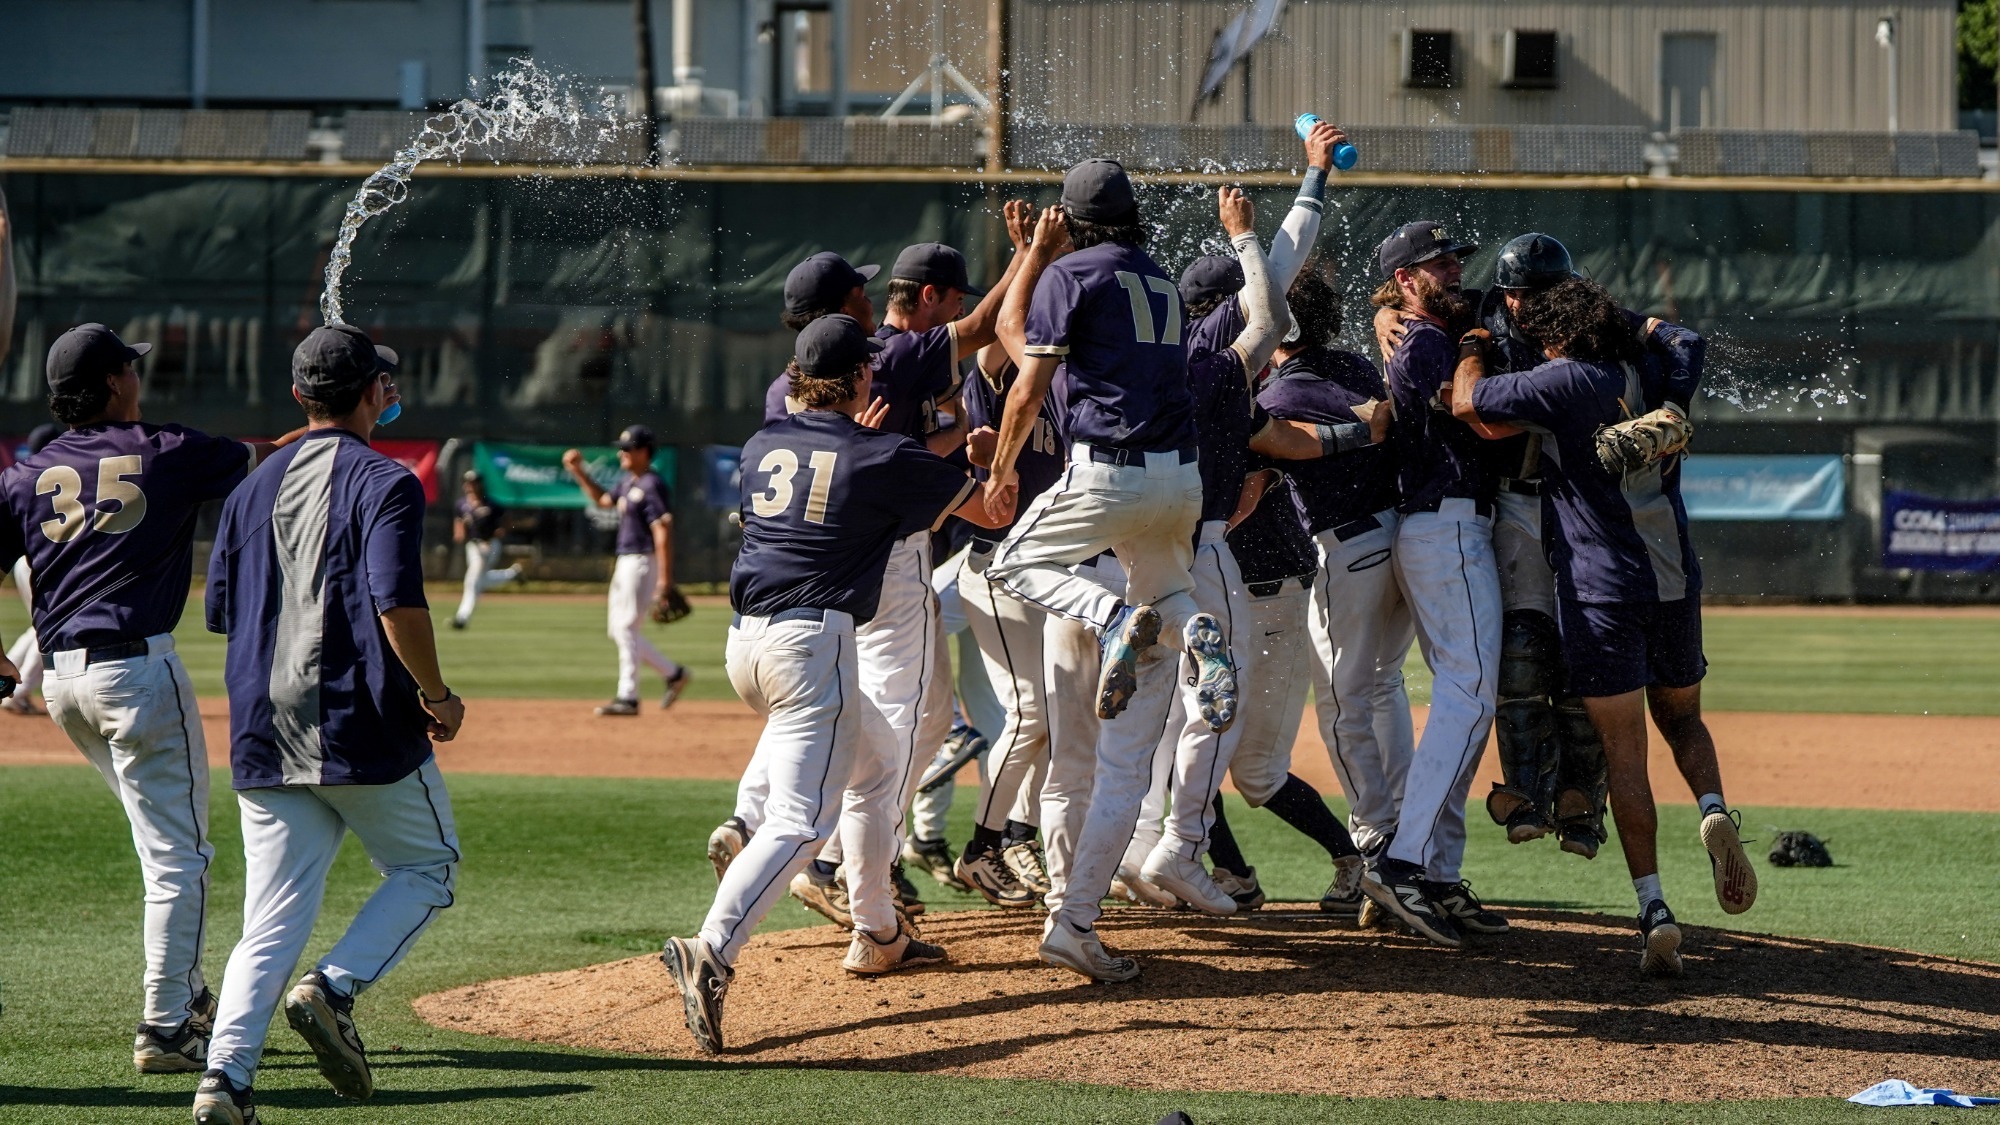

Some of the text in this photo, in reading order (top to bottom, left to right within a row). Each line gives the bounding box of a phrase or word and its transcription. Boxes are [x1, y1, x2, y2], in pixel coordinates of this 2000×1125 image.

[1114, 270, 1182, 346] 17
[1033, 416, 1056, 456] 18
[35, 454, 148, 543] 35
[751, 448, 838, 525] 31
